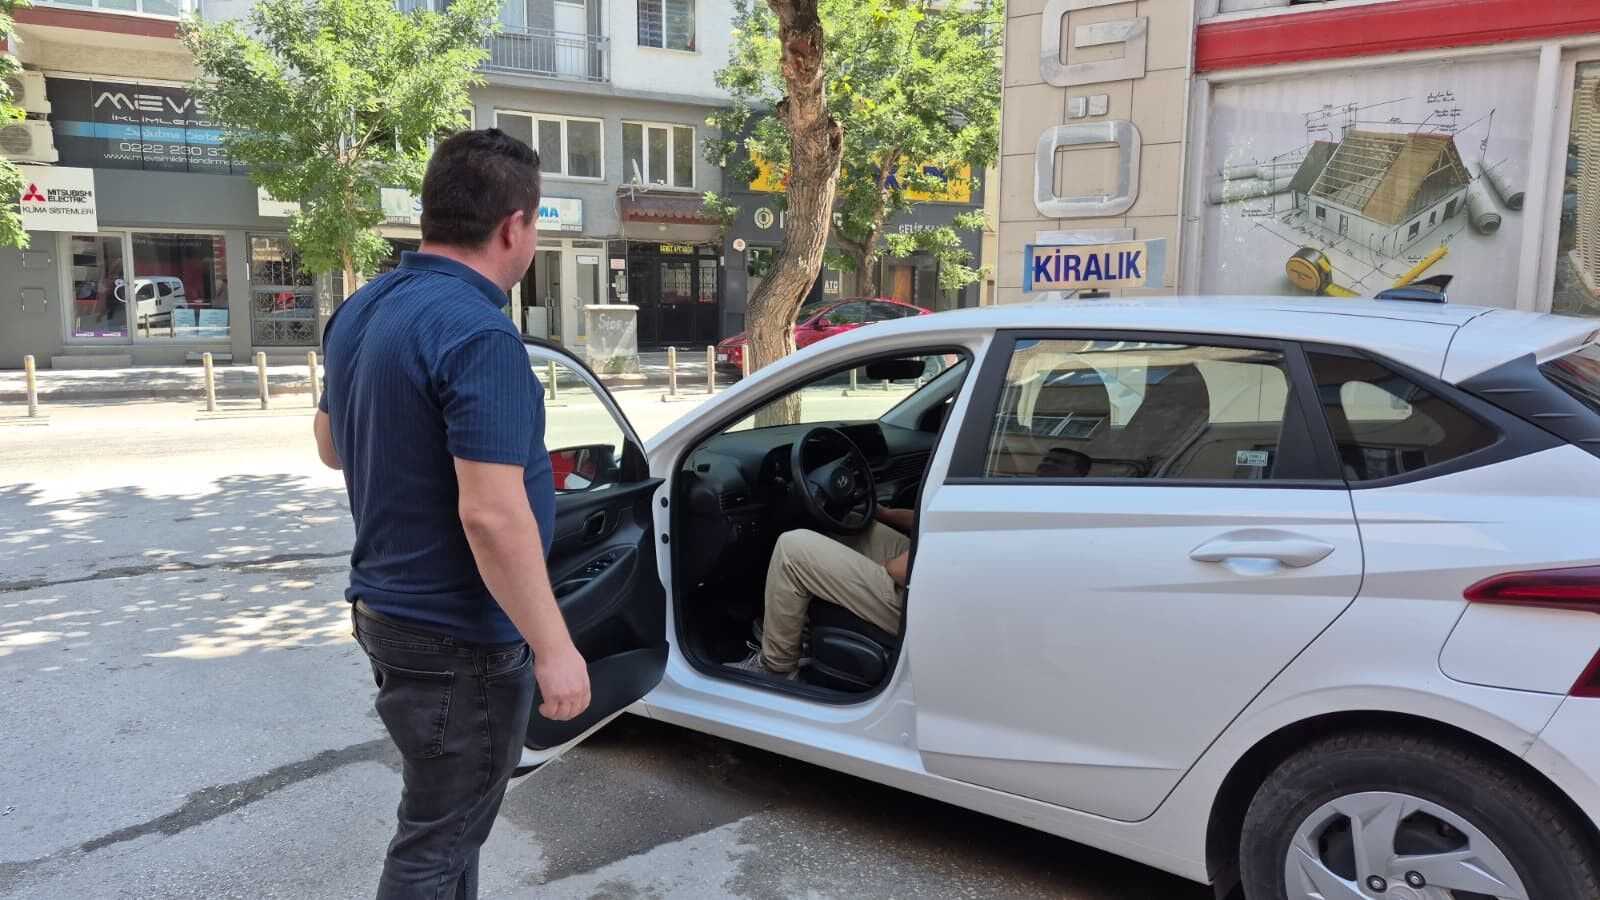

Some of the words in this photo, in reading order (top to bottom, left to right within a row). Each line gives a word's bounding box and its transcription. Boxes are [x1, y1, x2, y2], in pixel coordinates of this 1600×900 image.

[94, 91, 209, 115] MEVS
[119, 143, 164, 154] 0222
[169, 145, 202, 156] 230
[47, 189, 93, 197] MITSUBISHI
[1034, 249, 1142, 283] KİRALIK
